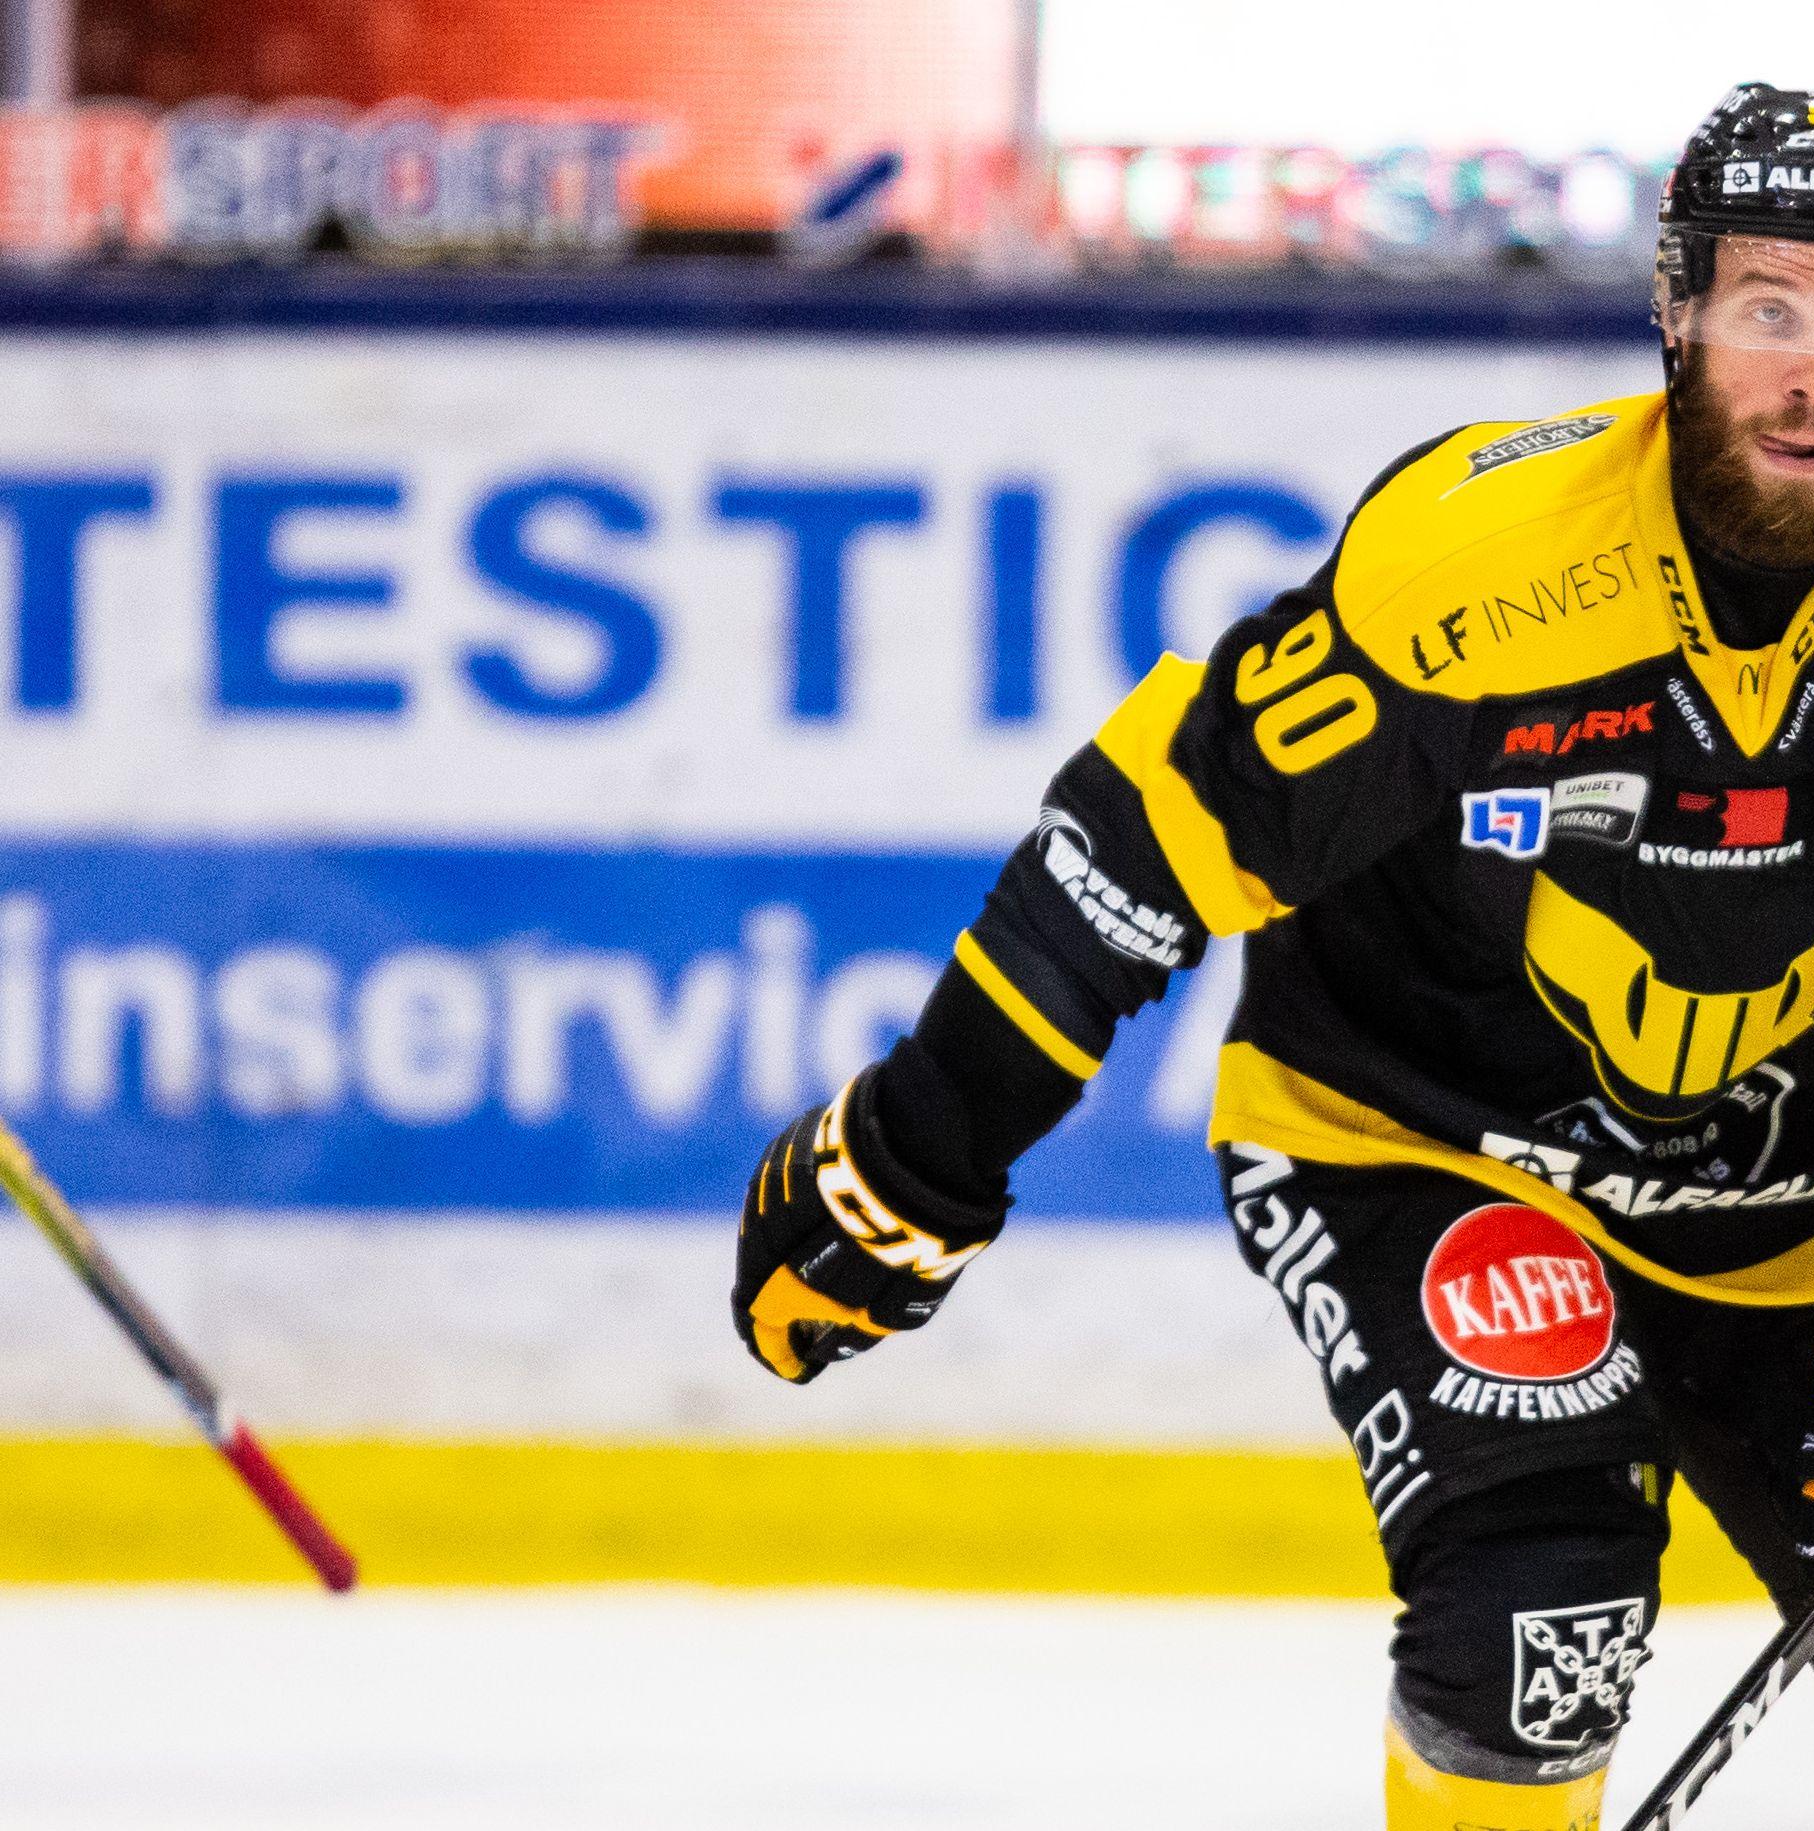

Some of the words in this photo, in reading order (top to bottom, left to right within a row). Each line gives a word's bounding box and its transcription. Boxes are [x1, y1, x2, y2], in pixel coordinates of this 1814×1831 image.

[1481, 541, 1639, 643] INVEST
[1657, 555, 1711, 657] CCM
[1234, 608, 1378, 777] 90
[1565, 779, 1627, 796] UNIBET
[1440, 1255, 1603, 1339] KAFFE
[1353, 1388, 1433, 1529] Bil
